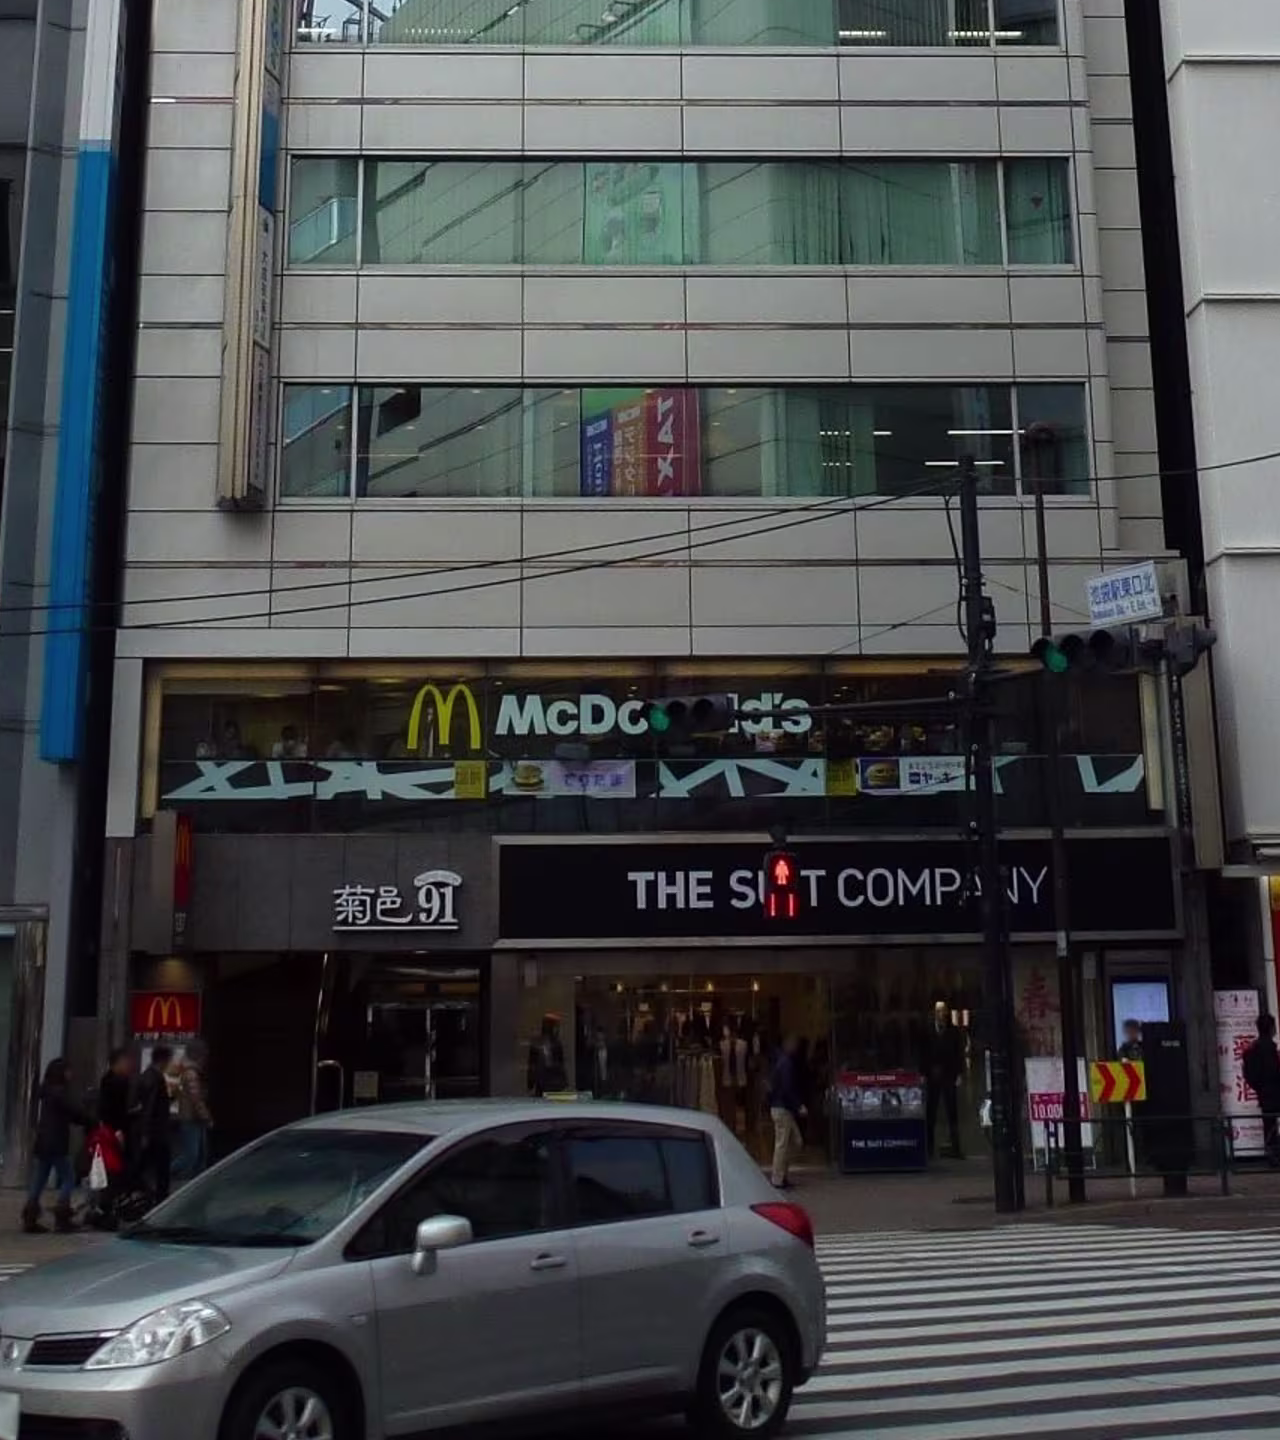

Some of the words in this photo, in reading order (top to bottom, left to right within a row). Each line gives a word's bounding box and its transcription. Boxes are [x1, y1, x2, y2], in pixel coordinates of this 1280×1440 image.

[332, 884, 412, 924] 菊邑
[417, 882, 459, 923] 91
[628, 871, 713, 909] THE
